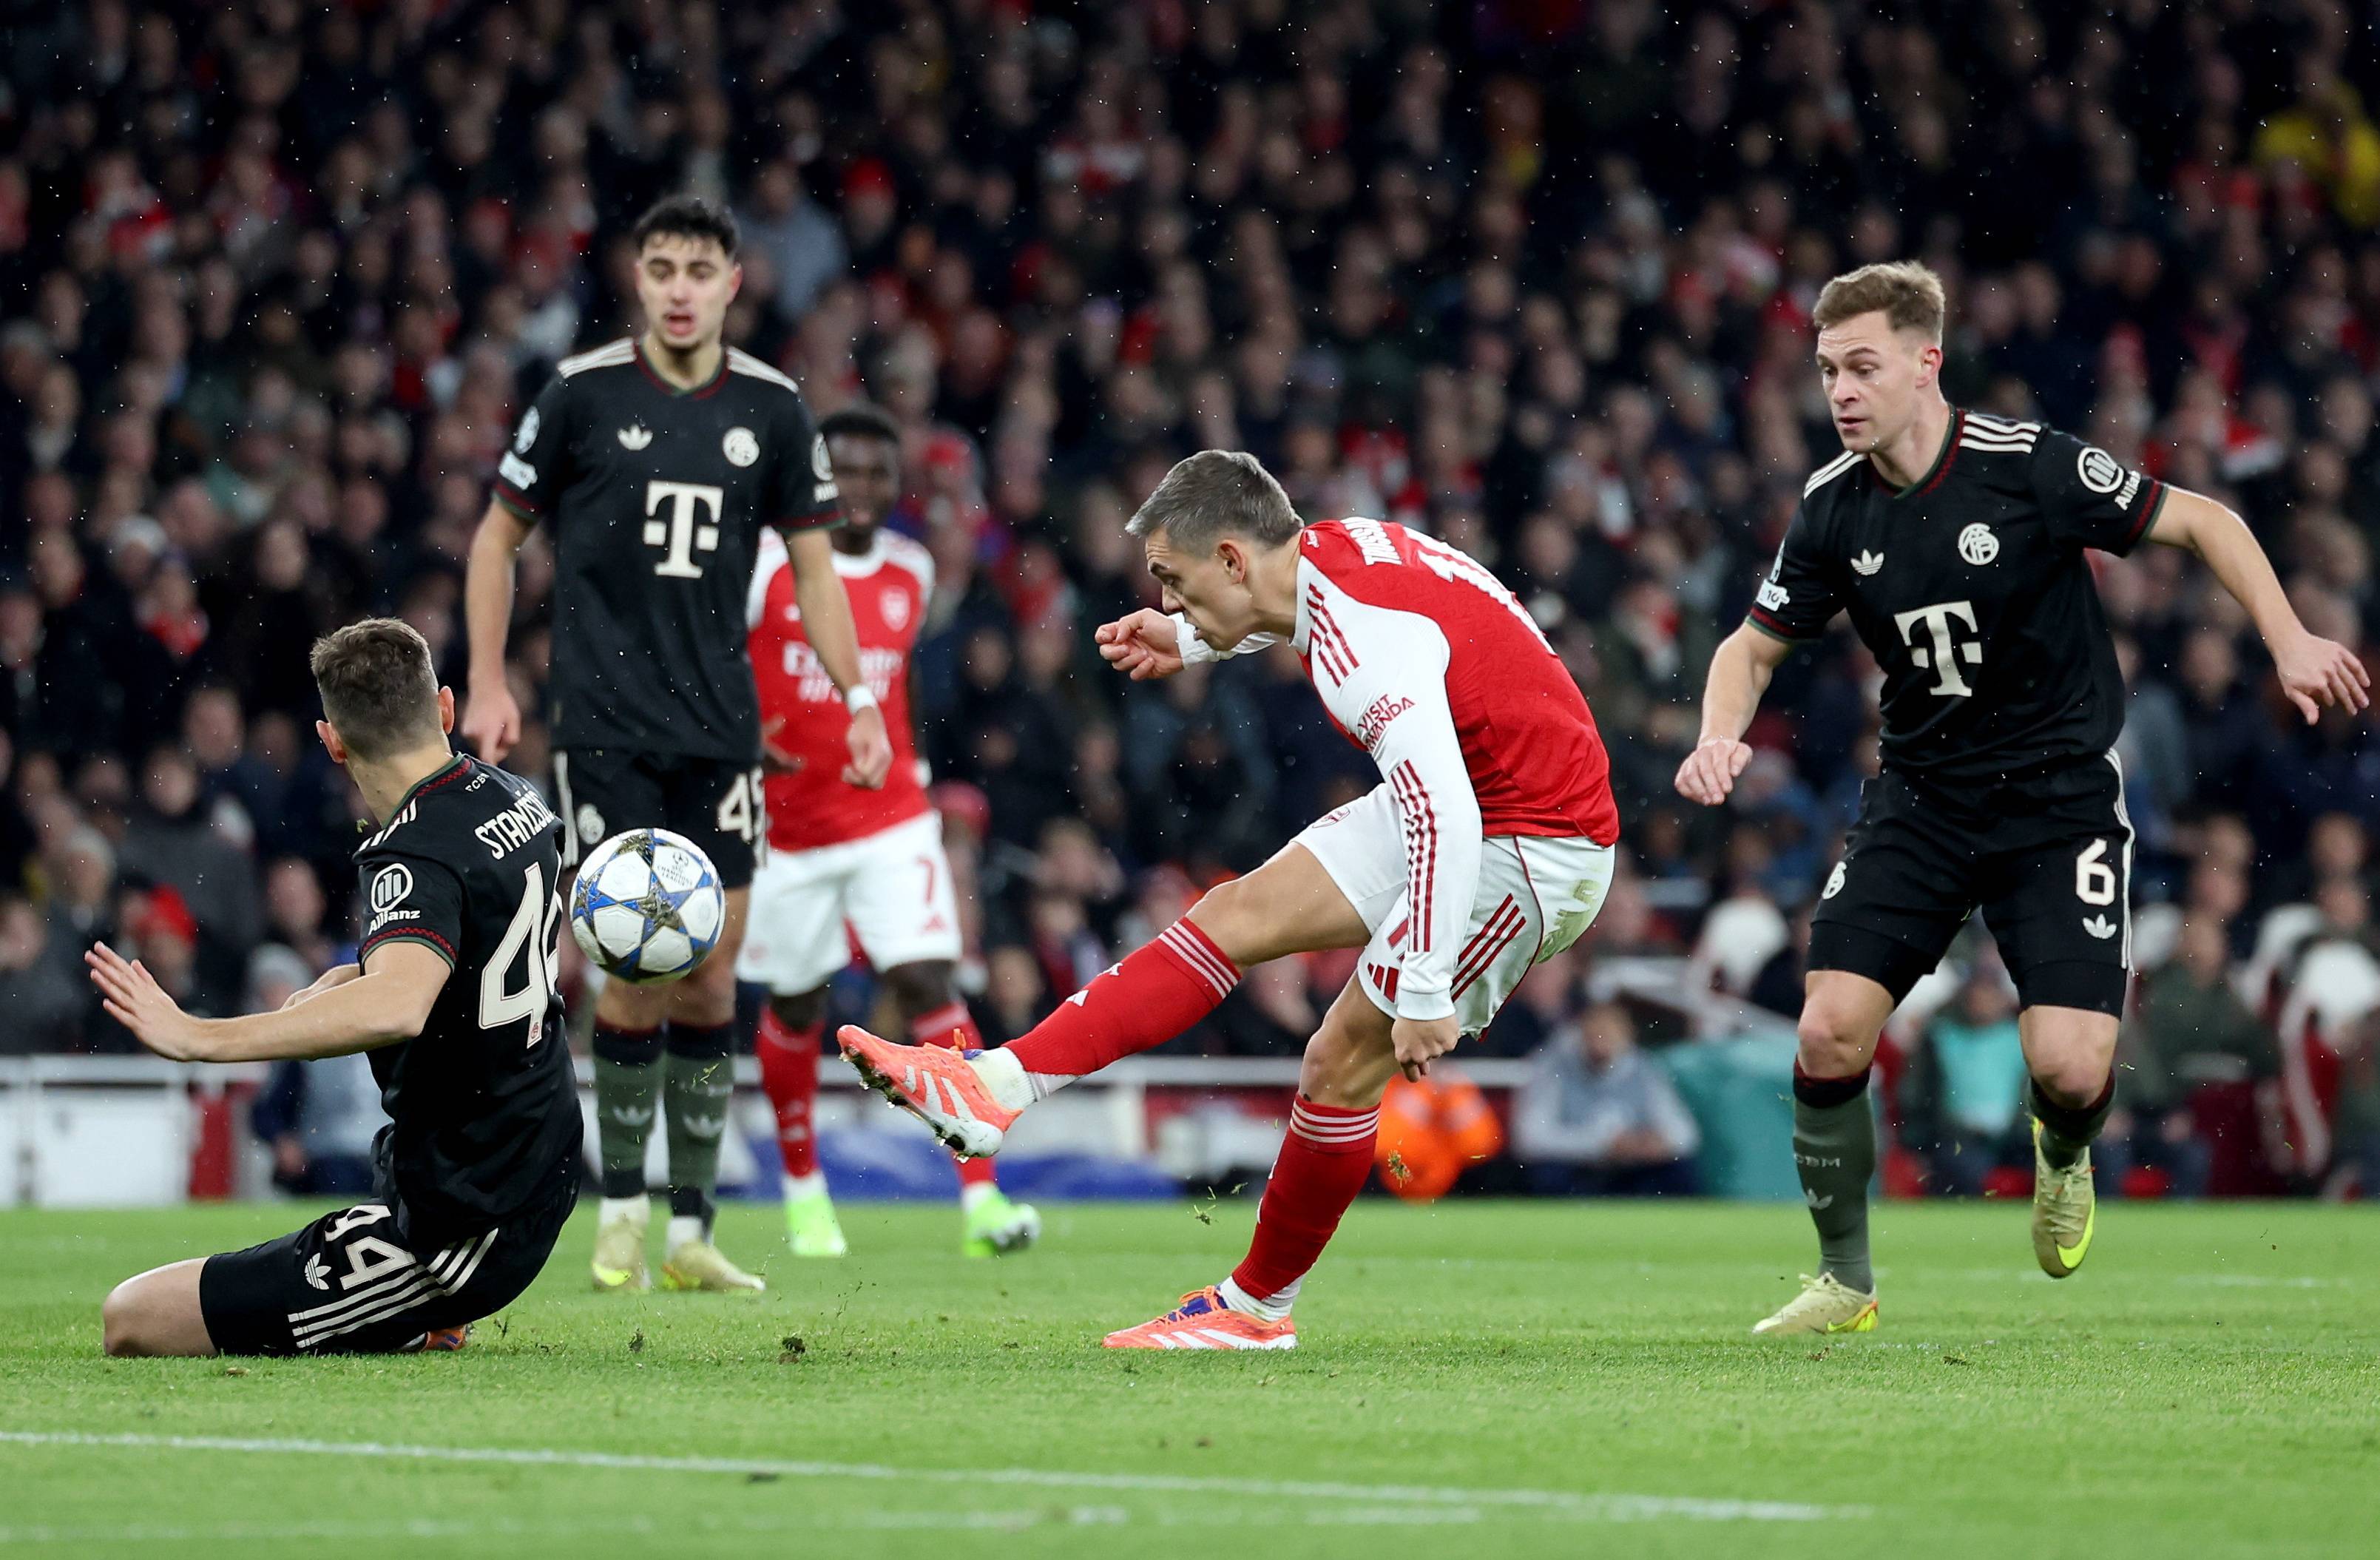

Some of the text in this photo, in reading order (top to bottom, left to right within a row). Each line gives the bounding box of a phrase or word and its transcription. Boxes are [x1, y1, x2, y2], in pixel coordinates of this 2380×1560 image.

[642, 481, 724, 578] T
[1893, 600, 1983, 698] T
[1358, 694, 1390, 731] VISIT
[916, 856, 936, 904] 7
[2076, 837, 2116, 906] 6
[368, 909, 421, 936] Allianz
[324, 1204, 416, 1291] 44
